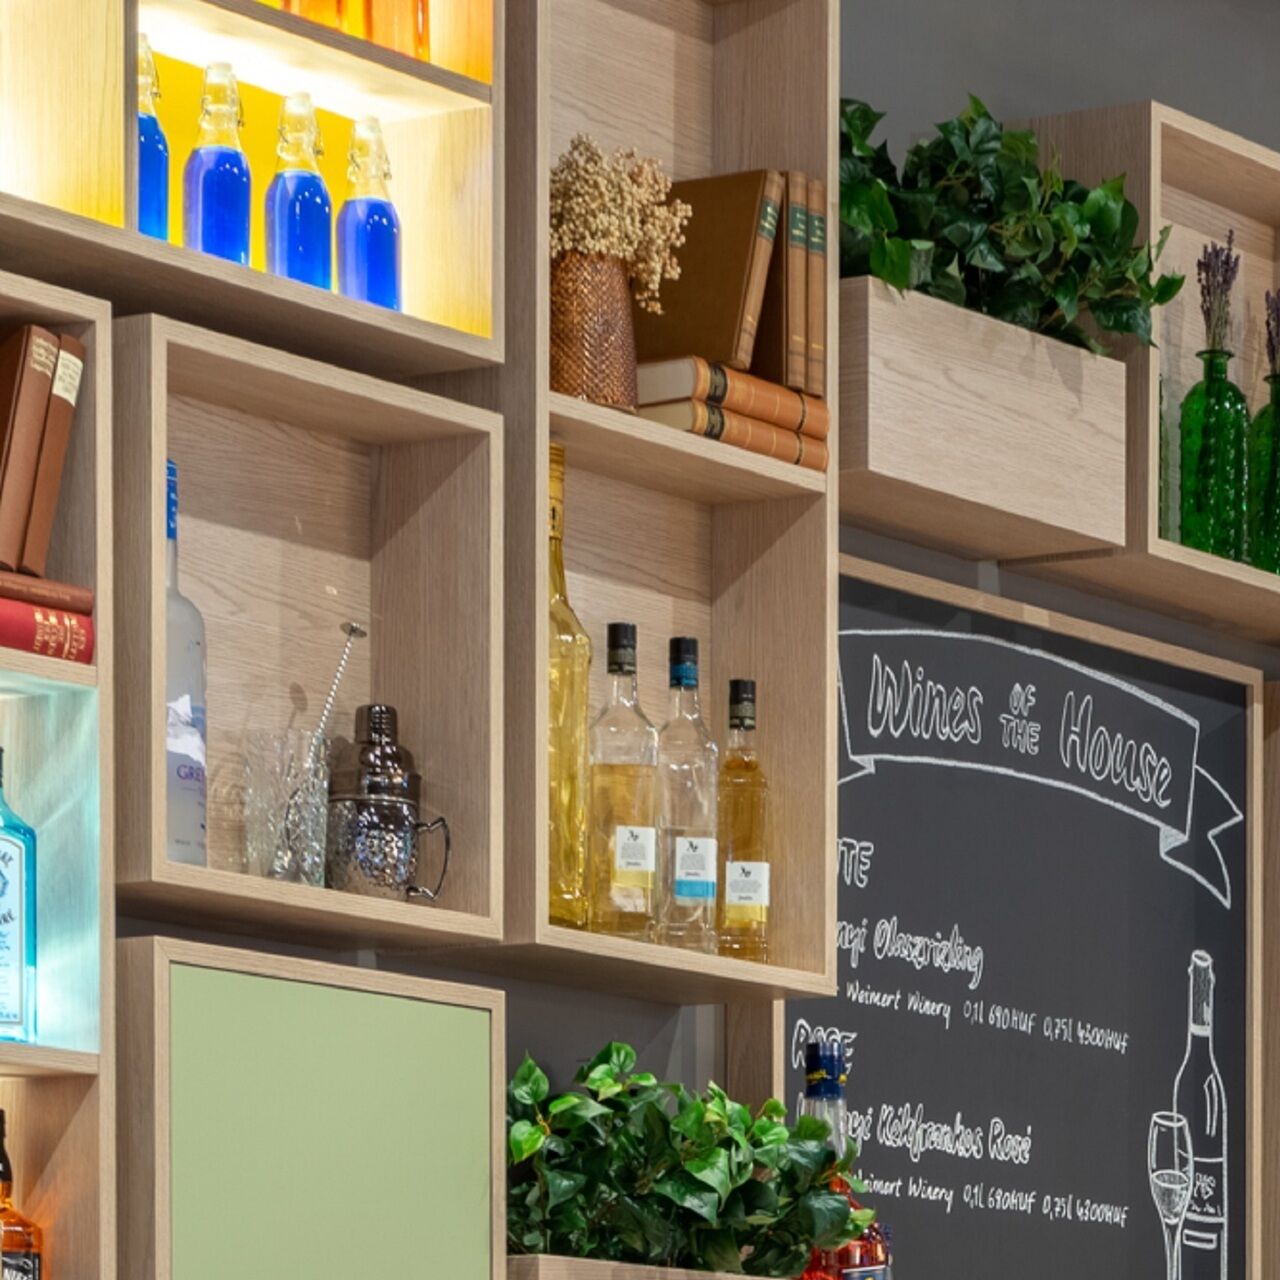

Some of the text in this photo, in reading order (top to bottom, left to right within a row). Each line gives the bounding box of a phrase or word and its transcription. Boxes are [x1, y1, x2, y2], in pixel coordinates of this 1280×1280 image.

[867, 653, 1173, 809] Wines OF THE House
[907, 990, 951, 1030] Winery
[988, 1116, 1032, 1165] Rosé
[907, 1176, 955, 1214] Winery
